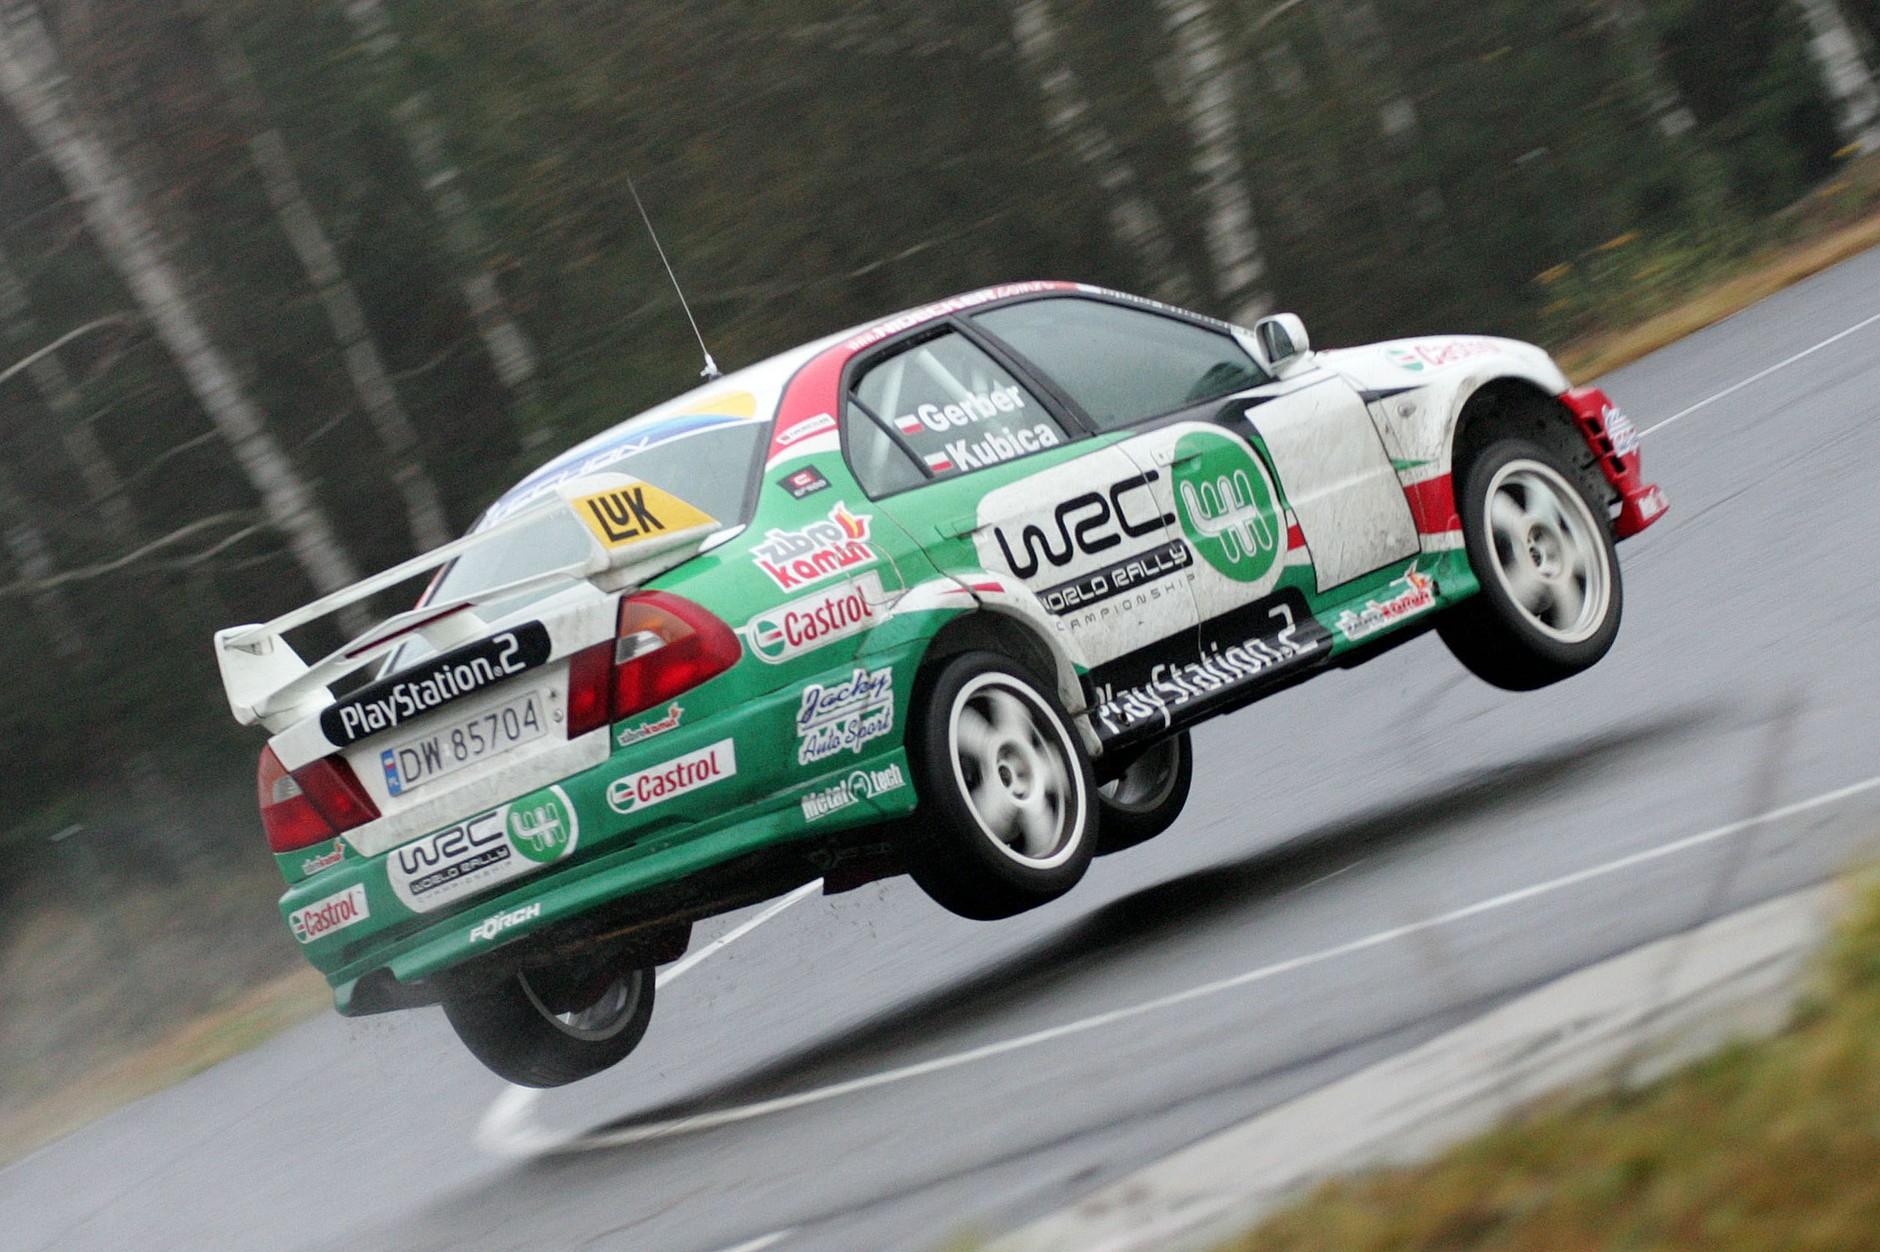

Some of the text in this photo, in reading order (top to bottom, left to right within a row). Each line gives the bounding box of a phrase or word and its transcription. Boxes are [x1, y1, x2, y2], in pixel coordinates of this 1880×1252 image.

[917, 385, 1025, 432] Gerber
[944, 422, 1060, 472] Kubica
[759, 523, 843, 565] zibro
[993, 469, 1176, 580] WRC
[760, 541, 872, 589] kamin
[1111, 544, 1188, 587] RALLY
[784, 585, 873, 647] Castrol
[797, 671, 889, 724] Jacky
[399, 698, 541, 784] DW 85704
[801, 705, 891, 761] Auto Sport
[637, 750, 721, 802] Castrol
[398, 812, 504, 875] WRC
[412, 845, 510, 893] WORLD RALLY
[303, 892, 359, 936] Castrol
